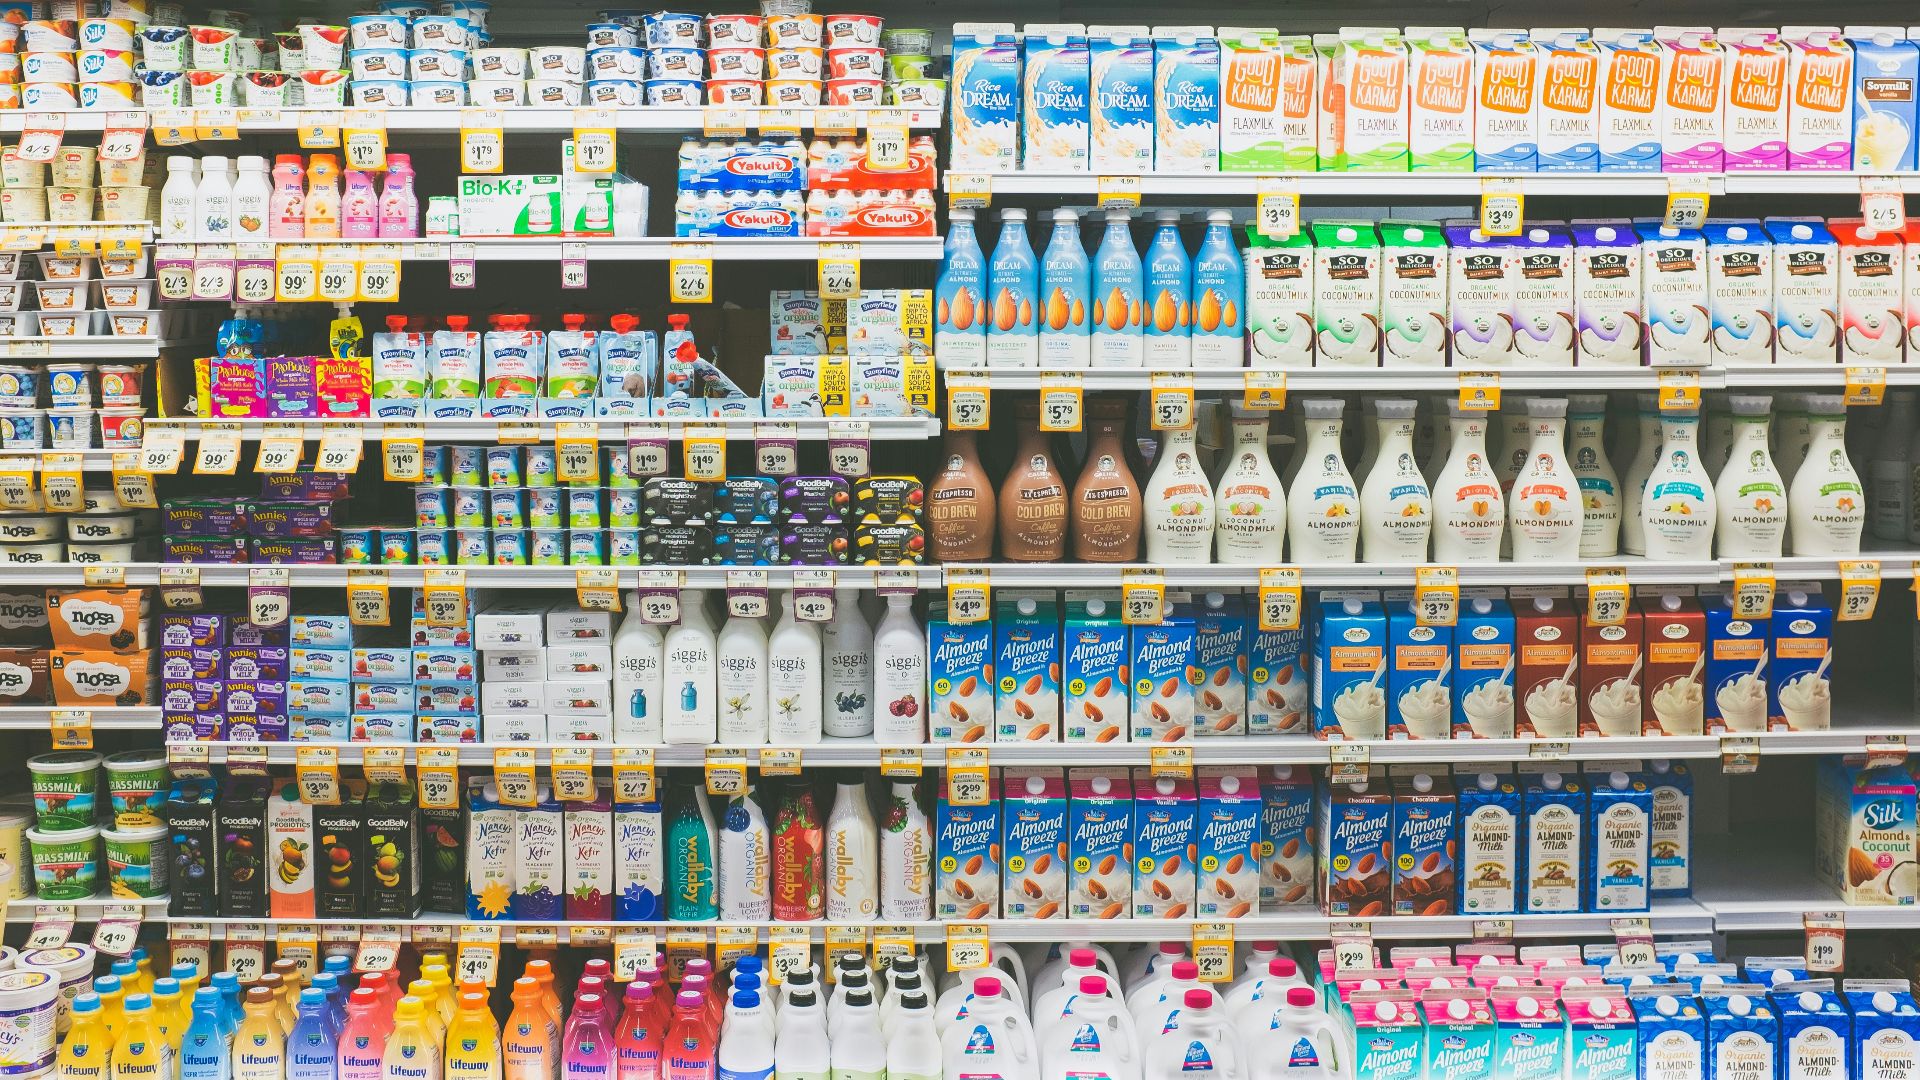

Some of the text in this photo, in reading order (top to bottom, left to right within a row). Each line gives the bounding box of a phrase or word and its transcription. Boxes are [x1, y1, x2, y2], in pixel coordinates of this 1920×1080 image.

[85, 24, 105, 43] Silk
[84, 55, 104, 74] Silk
[1617, 54, 1653, 81] GOOD
[1237, 57, 1275, 86] GOOD
[1490, 58, 1528, 87] GOOD
[975, 81, 1000, 92] Rice
[1111, 81, 1137, 93] Rice
[1178, 81, 1203, 93] Rice
[1867, 82, 1909, 91] Soymilk
[1232, 84, 1273, 107] KARMA
[1487, 85, 1528, 108] KARMA
[1612, 85, 1652, 108] KARMA
[1234, 118, 1273, 130] FLAXMILK
[1488, 120, 1528, 132] FLAXMILK
[1613, 118, 1652, 130] FLAXMILK
[738, 160, 784, 172] Yakult
[868, 213, 915, 223] Yakult
[1798, 253, 1814, 261] SO
[1322, 292, 1374, 300] COCONUTMILK
[1782, 287, 1832, 296] COCONUTMILK
[862, 301, 896, 310] Stonyfield
[779, 369, 814, 379] Stonyfield
[779, 381, 815, 392] organic
[378, 406, 416, 417] Stonyfield
[660, 481, 698, 489] GoodBelly
[796, 479, 833, 488] GoodBelly
[170, 509, 203, 520] Annie's
[1017, 505, 1065, 518] COLD BREW
[1081, 505, 1131, 518] COLD BREW
[1219, 524, 1275, 532] ALMONDMILK
[1649, 518, 1707, 526] ALMONDMILK
[3, 526, 36, 537] noosa
[72, 610, 114, 624] noosa
[164, 648, 191, 658] Annie's
[671, 648, 707, 663] siggi's
[1070, 638, 1123, 663] Almond
[1138, 640, 1191, 663] Almond
[721, 655, 756, 670] siggi's
[886, 655, 922, 669] siggi's
[1082, 652, 1120, 674] Breeze
[1148, 653, 1186, 674] Breeze
[1867, 803, 1904, 828] Silk
[367, 818, 408, 828] GoodBelly
[1075, 815, 1127, 841] Almond
[1203, 812, 1255, 840] Almond
[1399, 811, 1452, 838] Almond
[1472, 823, 1509, 833] Organic
[479, 822, 512, 840] Nancy's
[1860, 831, 1904, 841] Almond
[1088, 831, 1123, 852] Breeze
[1215, 829, 1251, 851] Breeze
[1411, 828, 1446, 849] Breeze
[482, 846, 507, 860] Kefir
[1478, 842, 1504, 851] Milk
[1863, 841, 1910, 852] Coconut
[679, 837, 688, 892] ORGANIC
[687, 835, 704, 904] wallaby
[777, 836, 786, 891] ORGANIC
[836, 829, 854, 897] wallaby
[507, 1043, 543, 1055] Lifeway
[1433, 1041, 1490, 1069] Almond
[1798, 1047, 1838, 1056] Organic
[241, 1054, 279, 1066] Lifeway
[450, 1059, 488, 1072] Lifeway
[568, 1062, 606, 1074] Lifeway
[1446, 1057, 1484, 1080] Breeze
[1804, 1066, 1831, 1077] Milk
